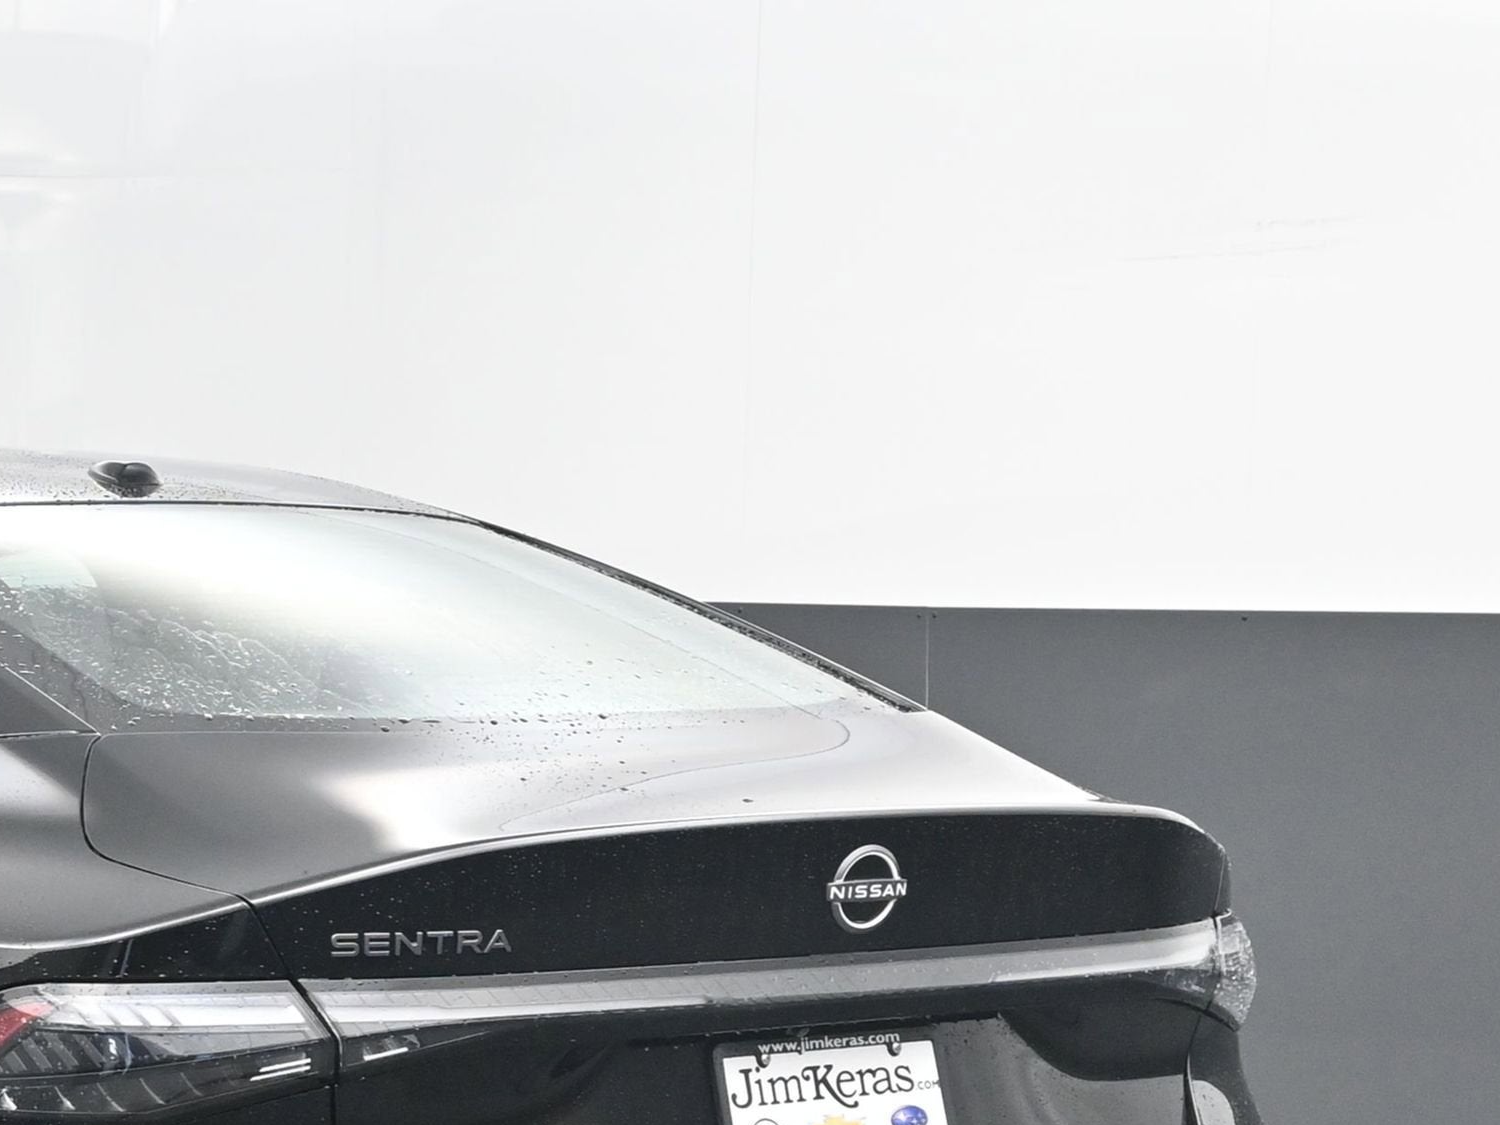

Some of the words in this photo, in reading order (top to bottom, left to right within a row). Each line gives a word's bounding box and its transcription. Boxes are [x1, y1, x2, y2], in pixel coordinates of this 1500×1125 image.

[829, 882, 908, 900] NISSAN
[330, 929, 512, 958] SENTRA
[757, 1031, 900, 1054] www.jimkeras.com
